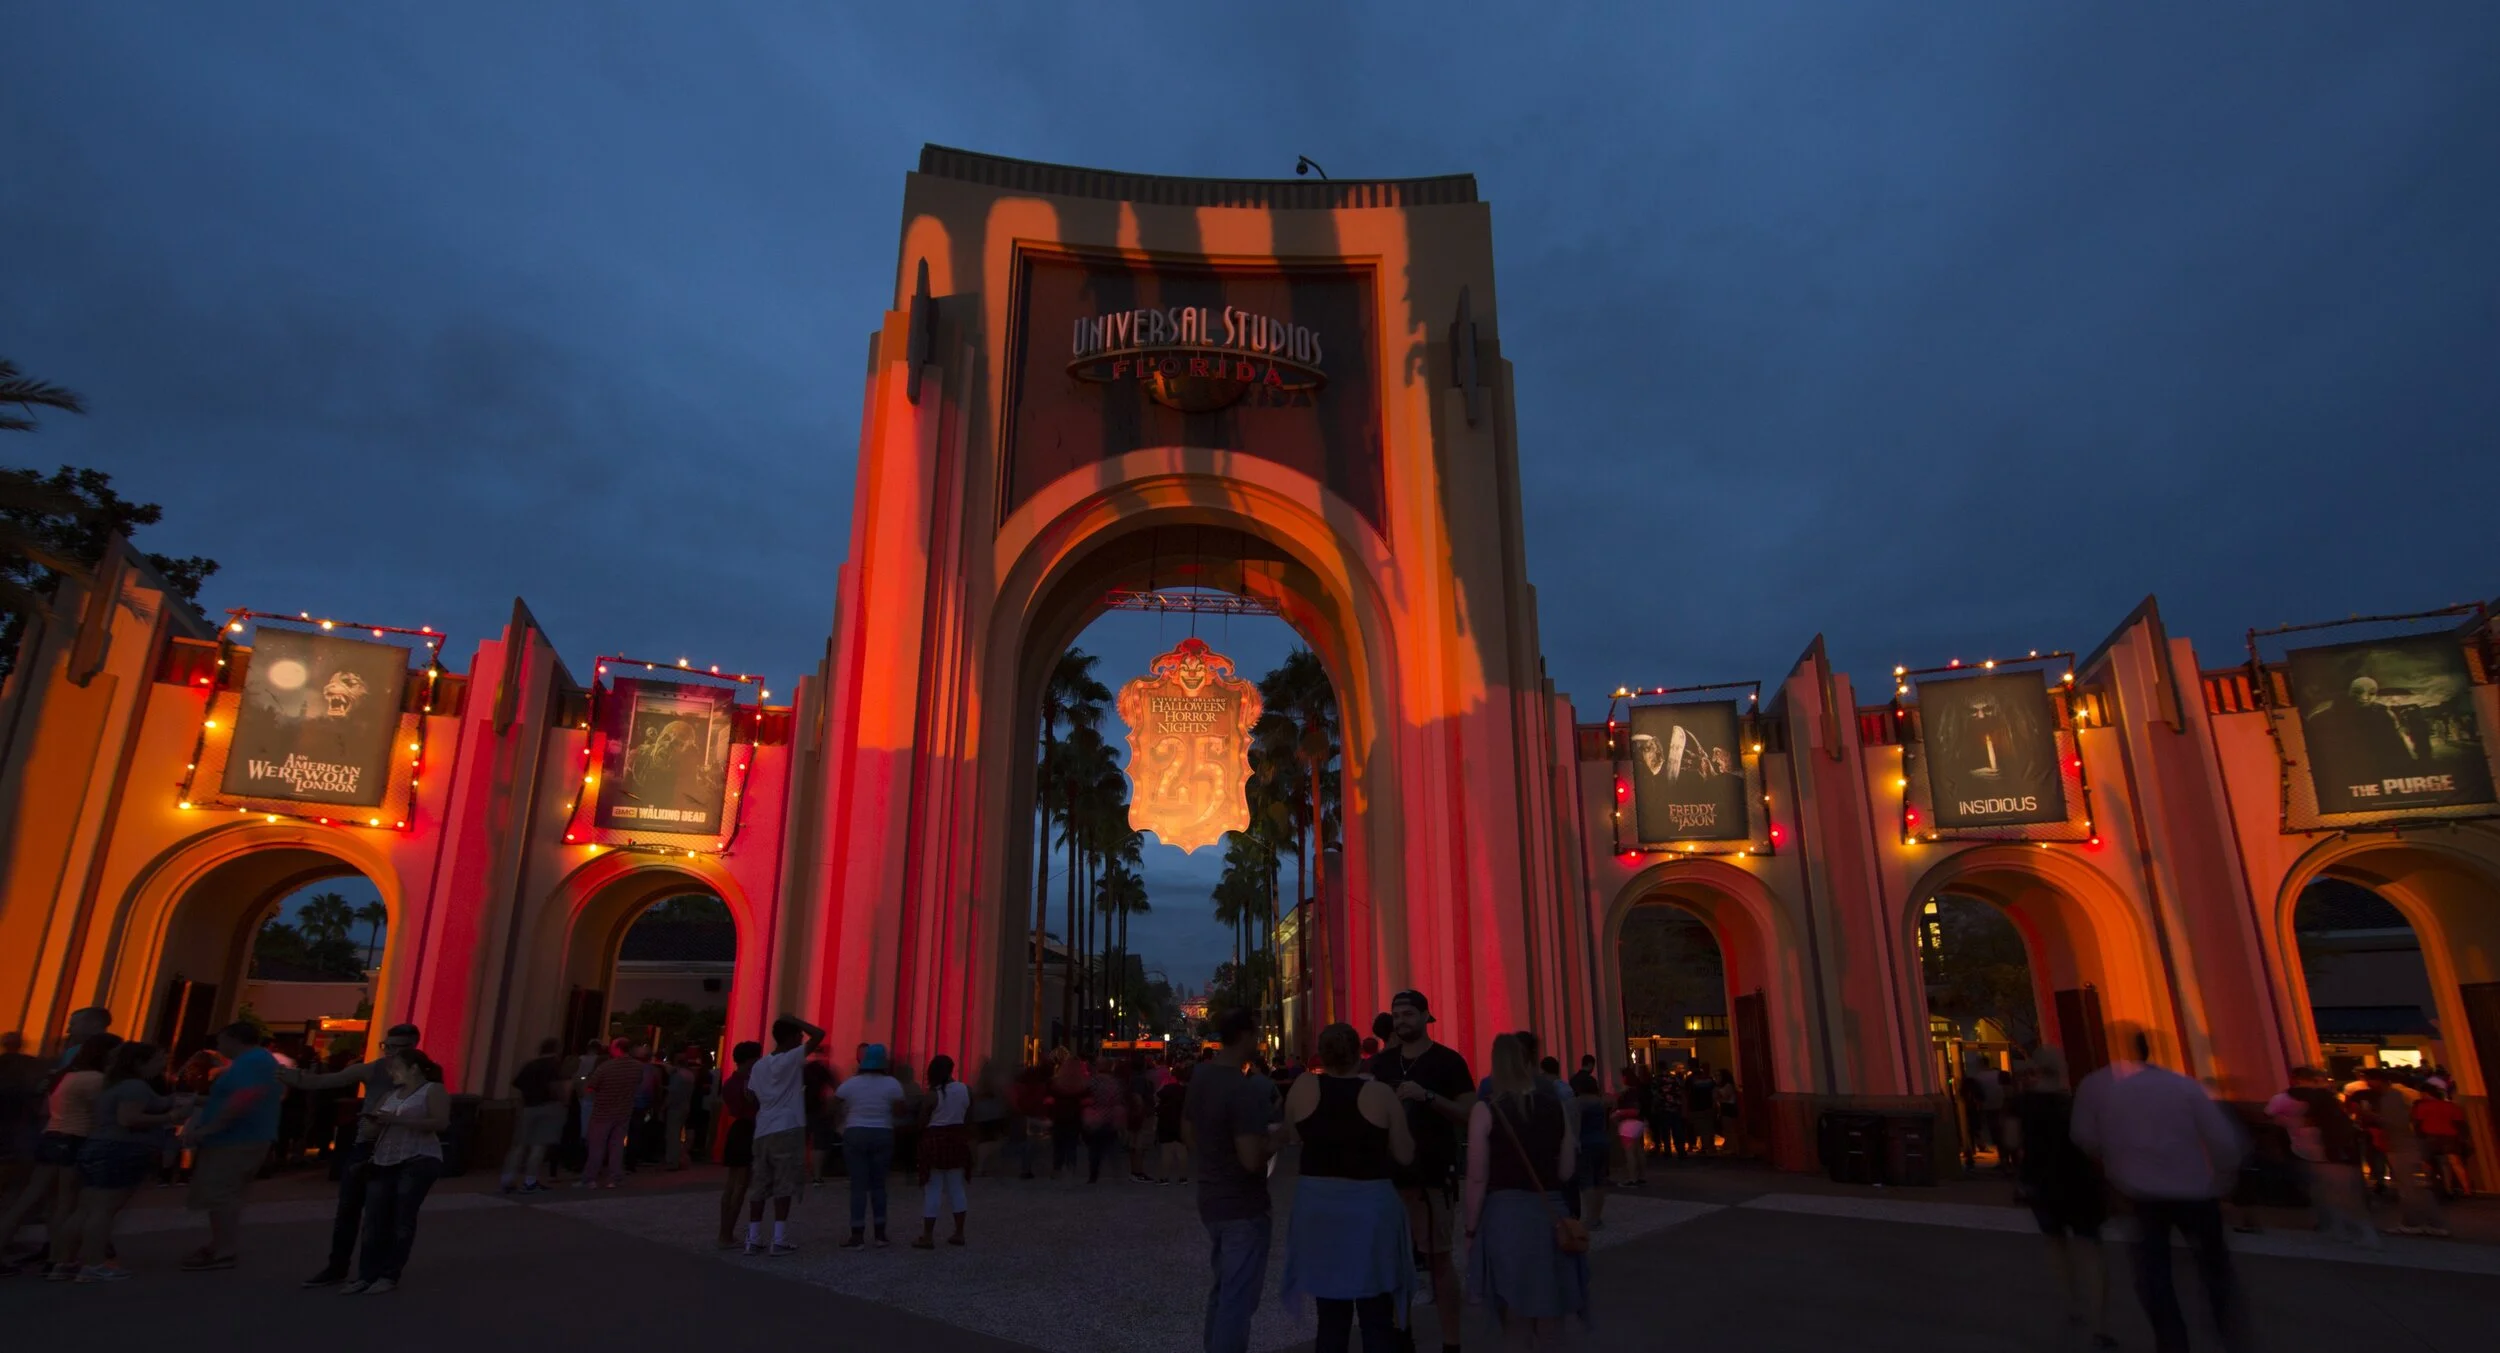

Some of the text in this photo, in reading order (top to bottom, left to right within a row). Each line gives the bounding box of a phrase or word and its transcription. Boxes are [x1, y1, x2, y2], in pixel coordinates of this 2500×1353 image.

[1072, 304, 1324, 366] UNIVERSAL STUDIOS
[1111, 355, 1284, 390] FLORIDA
[1152, 700, 1227, 713] HALLOWEEN
[1164, 711, 1217, 723] HORROR
[1157, 722, 1209, 734] NIGHTS
[248, 759, 361, 785] WEREWOLF
[284, 753, 361, 776] AMERICAN
[295, 779, 358, 793] LONDON
[1151, 735, 1229, 826] 25
[2348, 774, 2456, 797] THE PURGE
[1668, 803, 1716, 817] FREDDY
[1959, 796, 2038, 815] INSIDIOUS
[639, 807, 681, 822] WALKING
[681, 810, 707, 823] DEAD
[1678, 814, 1717, 831] JASON
